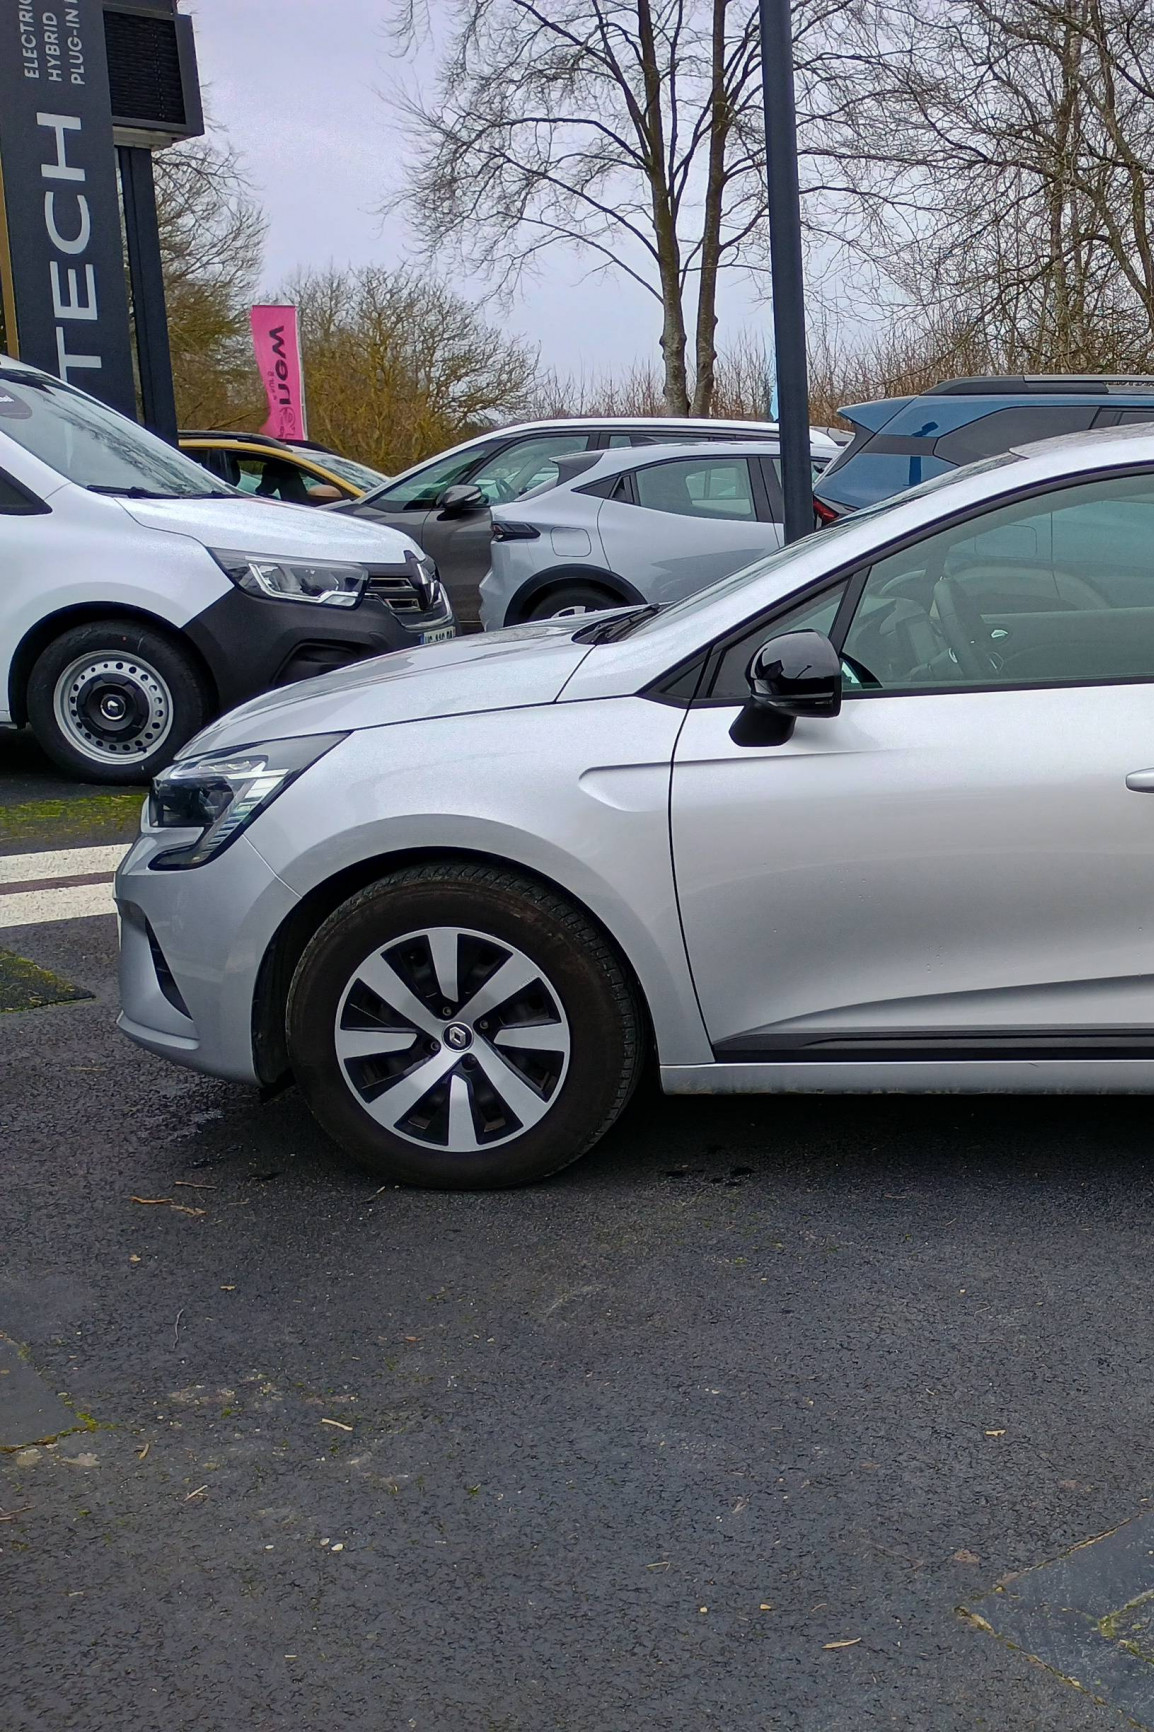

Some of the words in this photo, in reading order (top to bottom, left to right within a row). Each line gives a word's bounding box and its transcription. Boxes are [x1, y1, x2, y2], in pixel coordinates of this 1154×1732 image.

[42, 11, 63, 82] HYBRID
[64, 8, 86, 85] PLUG-IN
[36, 111, 103, 383] TECH
